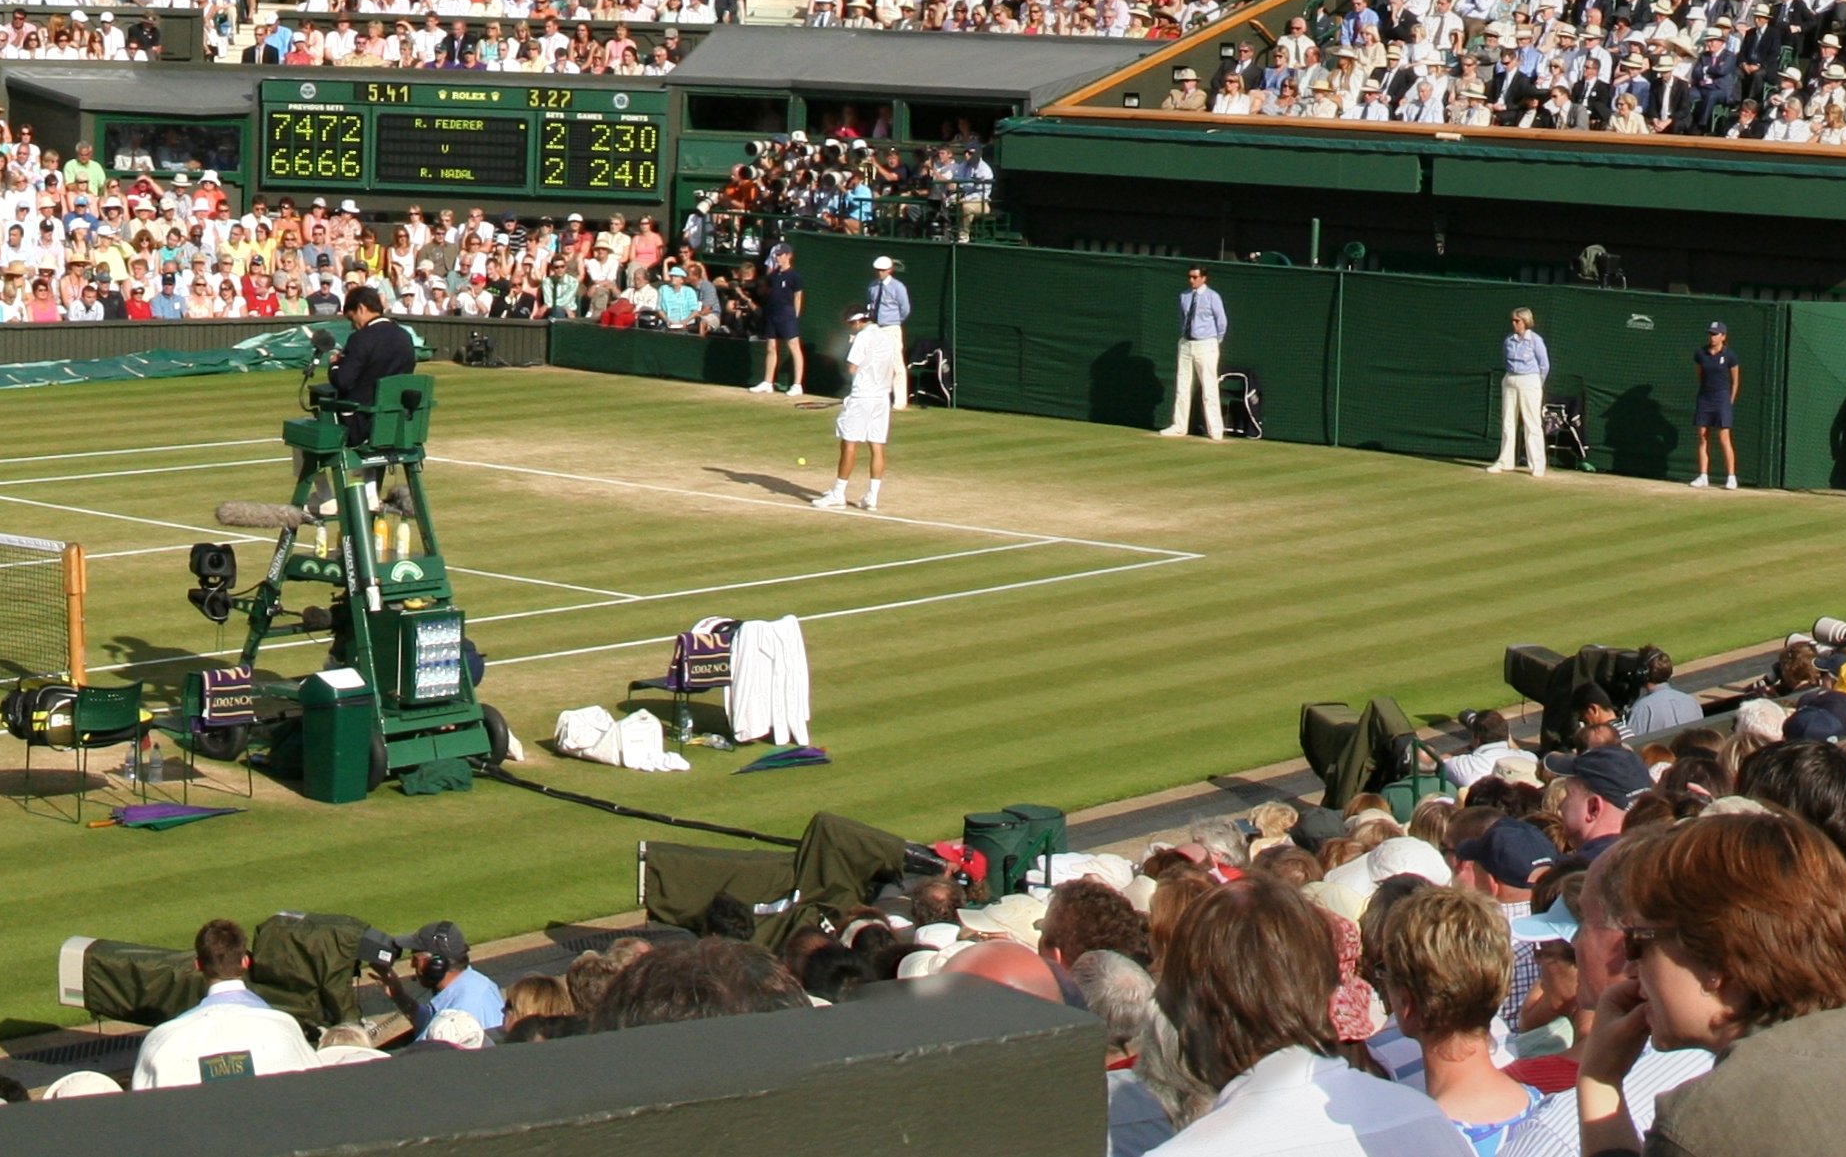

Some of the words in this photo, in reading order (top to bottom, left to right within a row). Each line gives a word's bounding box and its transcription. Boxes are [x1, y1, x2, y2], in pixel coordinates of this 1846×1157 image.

[368, 84, 409, 102] 5.41
[452, 91, 486, 101] ROLEX
[529, 89, 571, 108] 3.27
[326, 104, 344, 112] SETS
[620, 114, 649, 122] POINTS
[435, 119, 484, 130] FEDERER
[440, 169, 475, 180] NADAL
